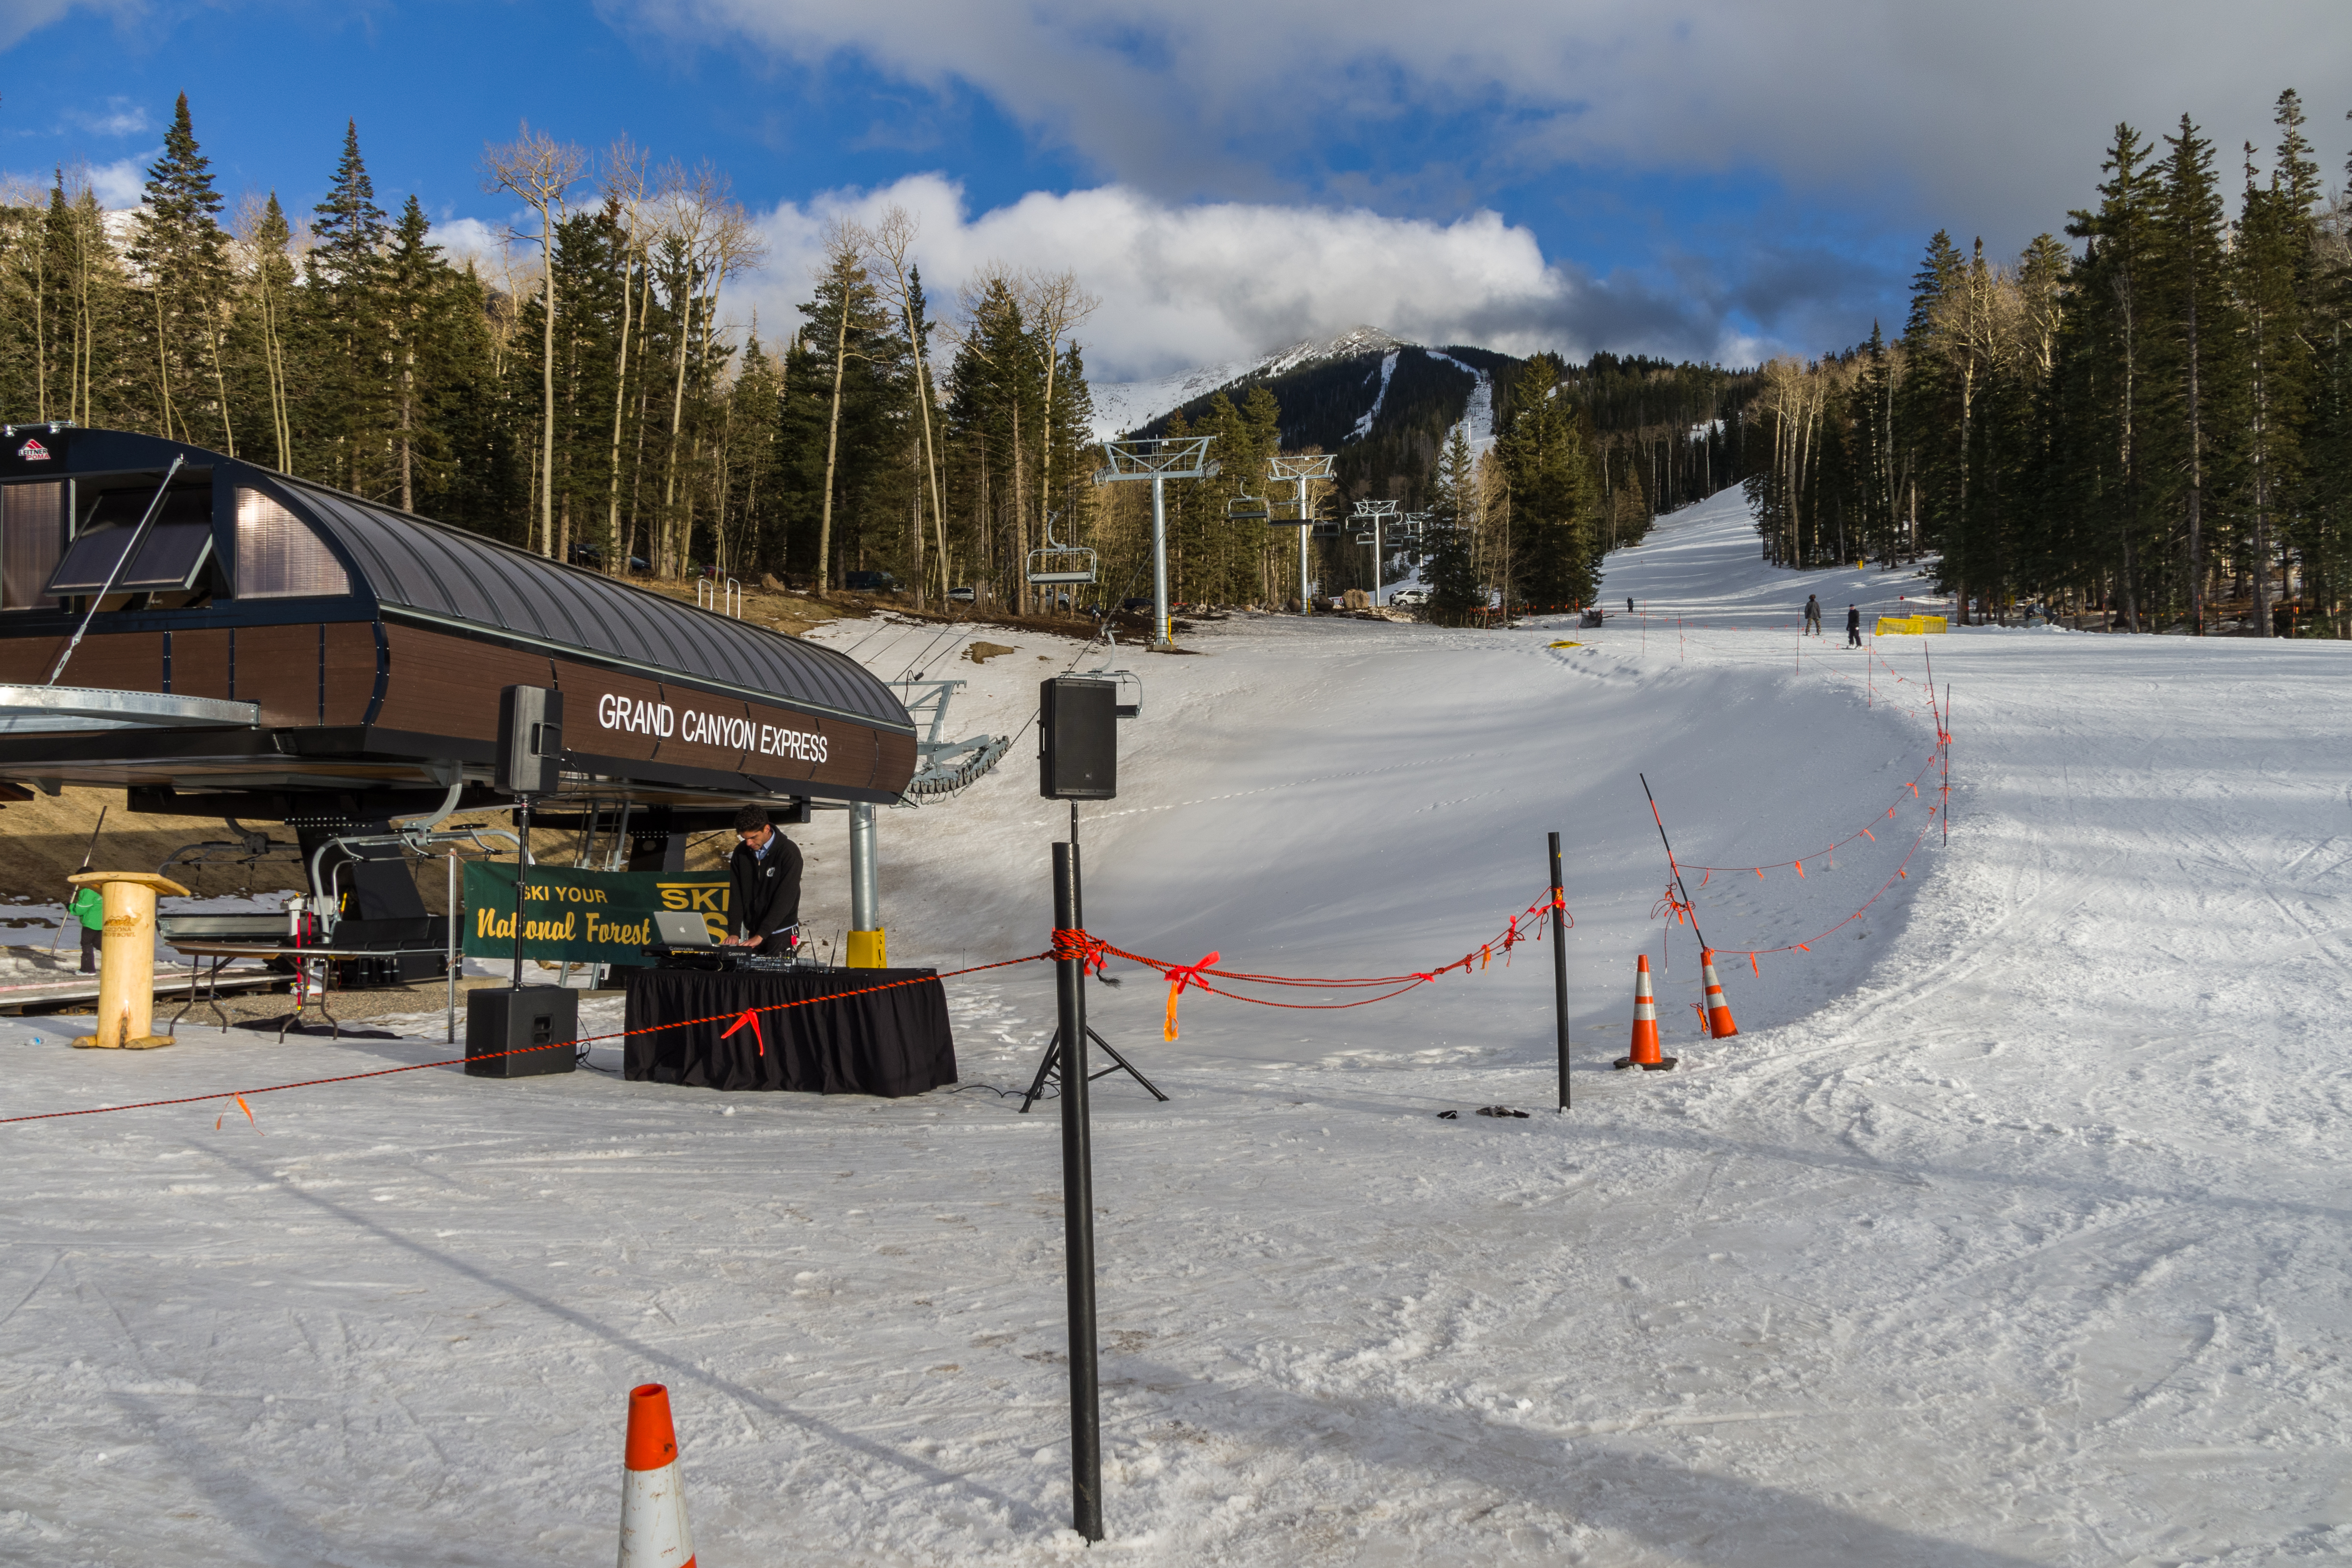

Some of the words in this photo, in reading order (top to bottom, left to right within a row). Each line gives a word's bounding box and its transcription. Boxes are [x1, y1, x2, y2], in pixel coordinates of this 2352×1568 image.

[599, 694, 674, 737] GRAND
[682, 710, 756, 751] CANYON
[760, 725, 828, 762] EXPRESS
[555, 887, 608, 903] YOUR
[662, 889, 730, 911] SKI
[478, 908, 576, 941] Natonal
[586, 913, 651, 945] Forest
